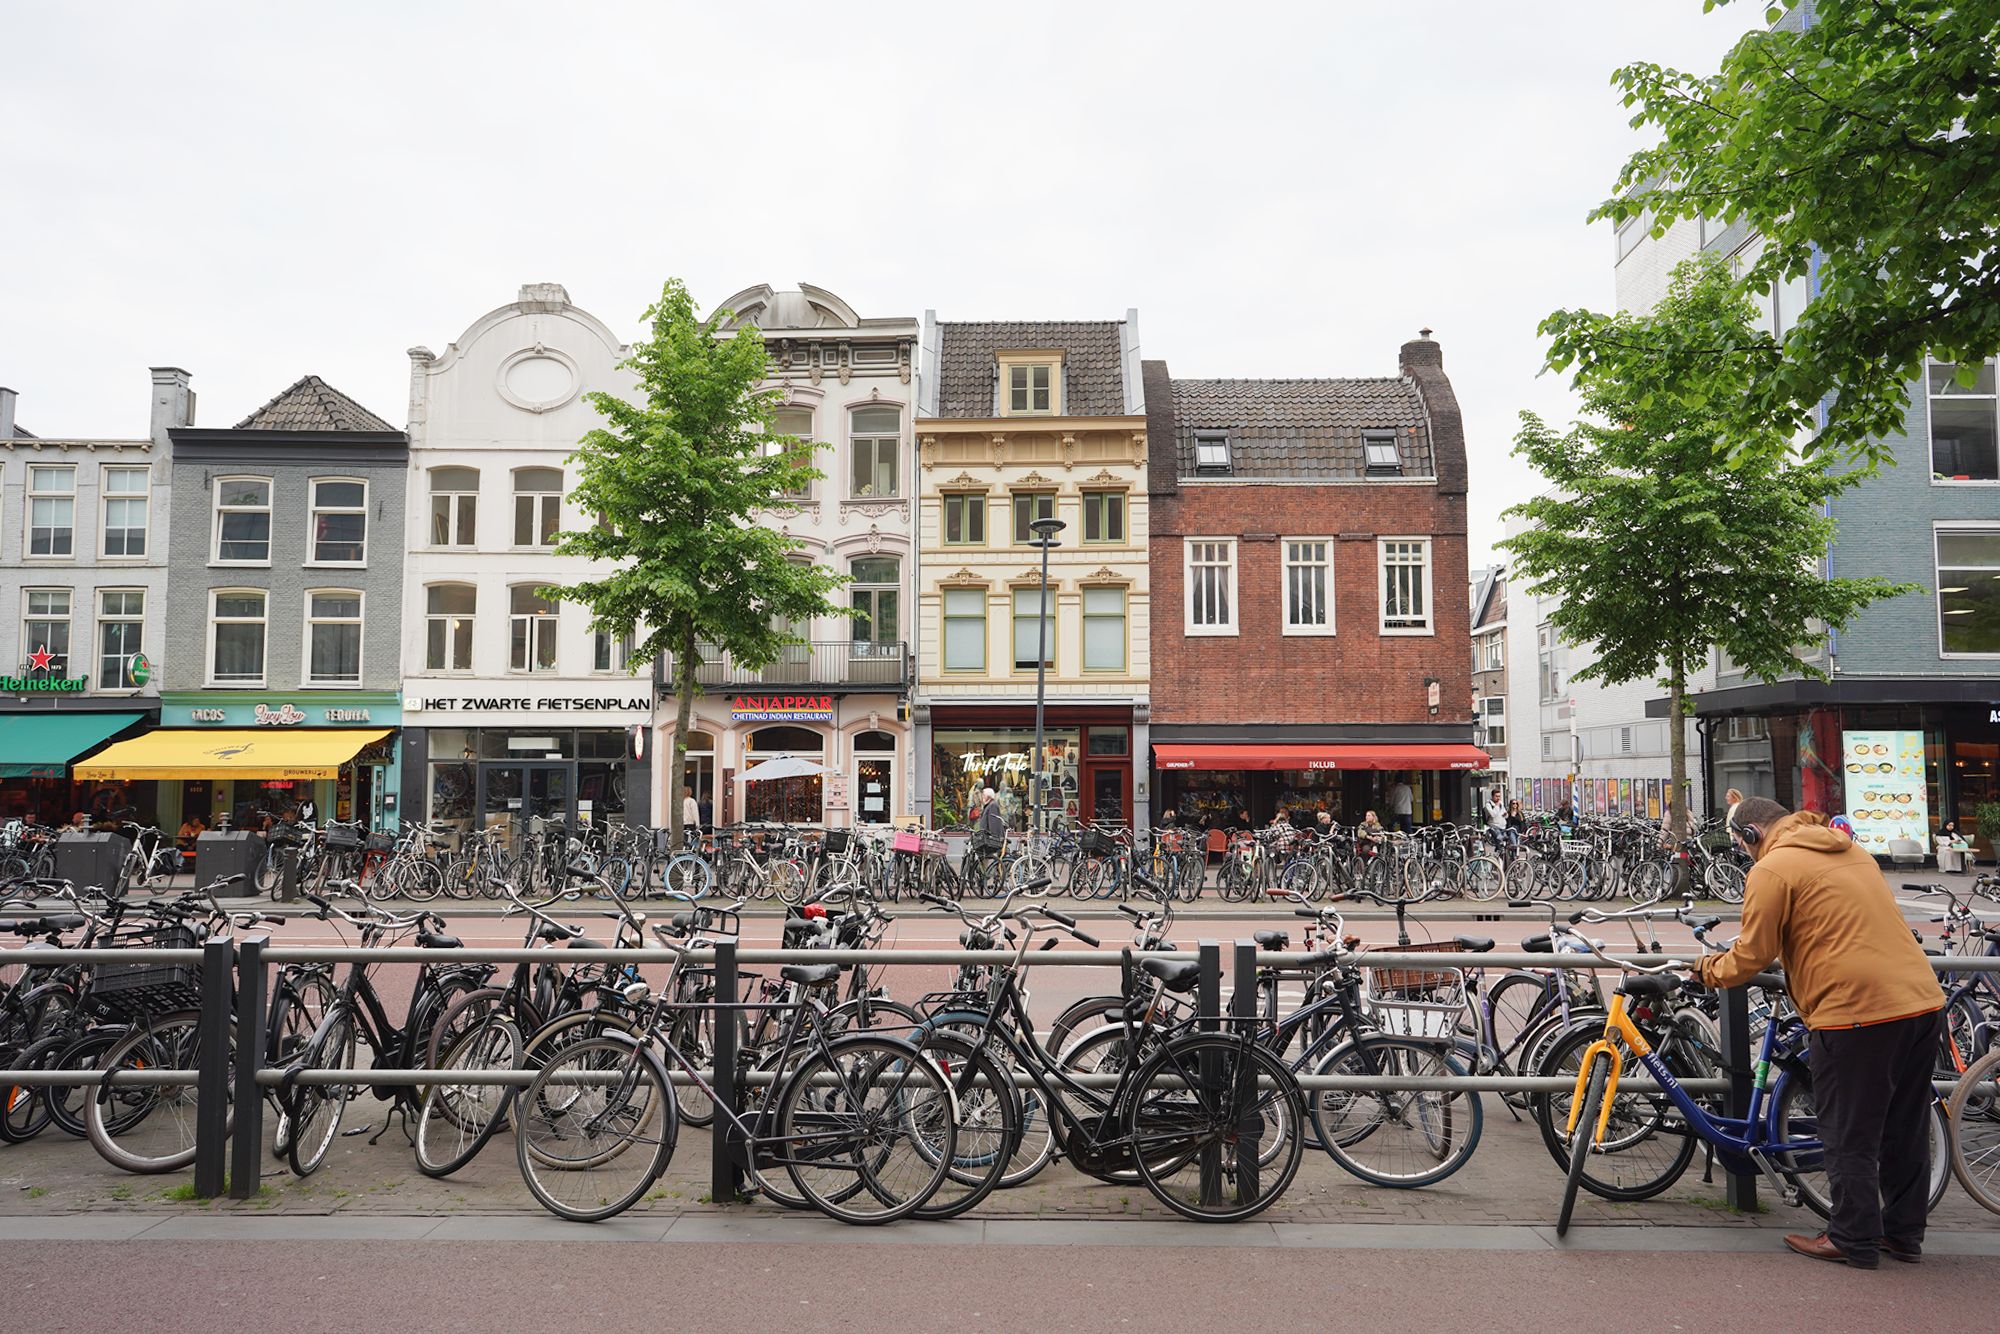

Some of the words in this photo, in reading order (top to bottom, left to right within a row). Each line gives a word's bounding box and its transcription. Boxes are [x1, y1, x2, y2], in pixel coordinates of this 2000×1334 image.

[0, 675, 86, 691] Heineken
[425, 698, 457, 710] HET
[462, 698, 531, 710] ZWARTE
[537, 698, 650, 710] FIETSENPLAN
[732, 696, 832, 712] ANJAPPAR
[192, 709, 225, 721] TACOS
[255, 704, 281, 725] Lucy
[281, 704, 306, 725] Lou
[326, 709, 370, 721] TEQUILA
[960, 752, 1001, 776] Thrift
